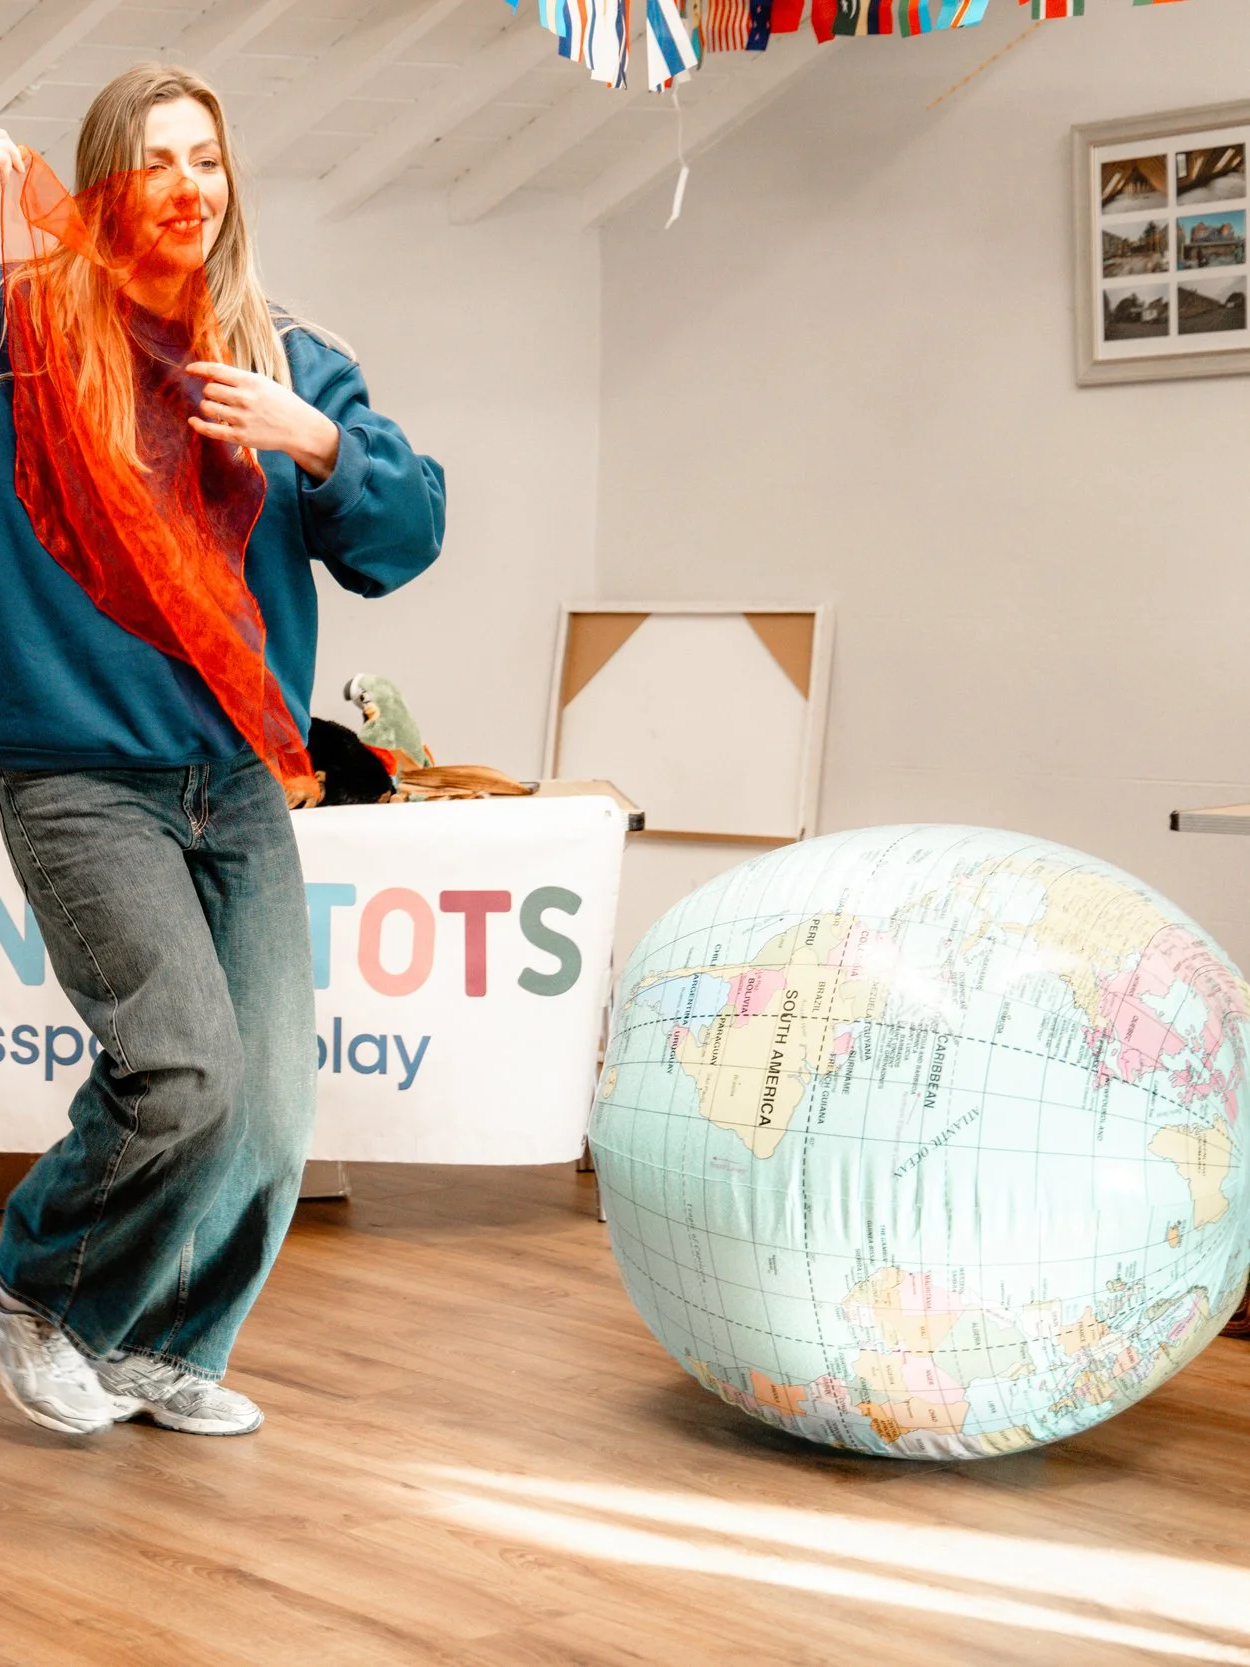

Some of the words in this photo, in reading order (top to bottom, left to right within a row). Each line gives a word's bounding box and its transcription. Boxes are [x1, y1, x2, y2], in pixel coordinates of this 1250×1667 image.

[805, 918, 821, 946] PERU
[850, 930, 870, 977] COLIA
[682, 973, 700, 1026] ARGENTINA
[740, 977, 756, 1014] BOLIVIA
[775, 989, 799, 1045] SOUTH
[811, 980, 827, 1012] BRAZIL
[865, 976, 880, 1019] NEZUELA
[666, 1030, 682, 1075] URUGUAY
[709, 1016, 727, 1066] PARAGUAY
[759, 1049, 784, 1126] AMERICA
[842, 1049, 857, 1095] SURINAME
[923, 1034, 949, 1109] CARIBBEAN
[817, 1090, 831, 1125] GUIANA
[931, 1107, 980, 1149] ATLANTIC
[893, 1146, 929, 1179] OCEAN
